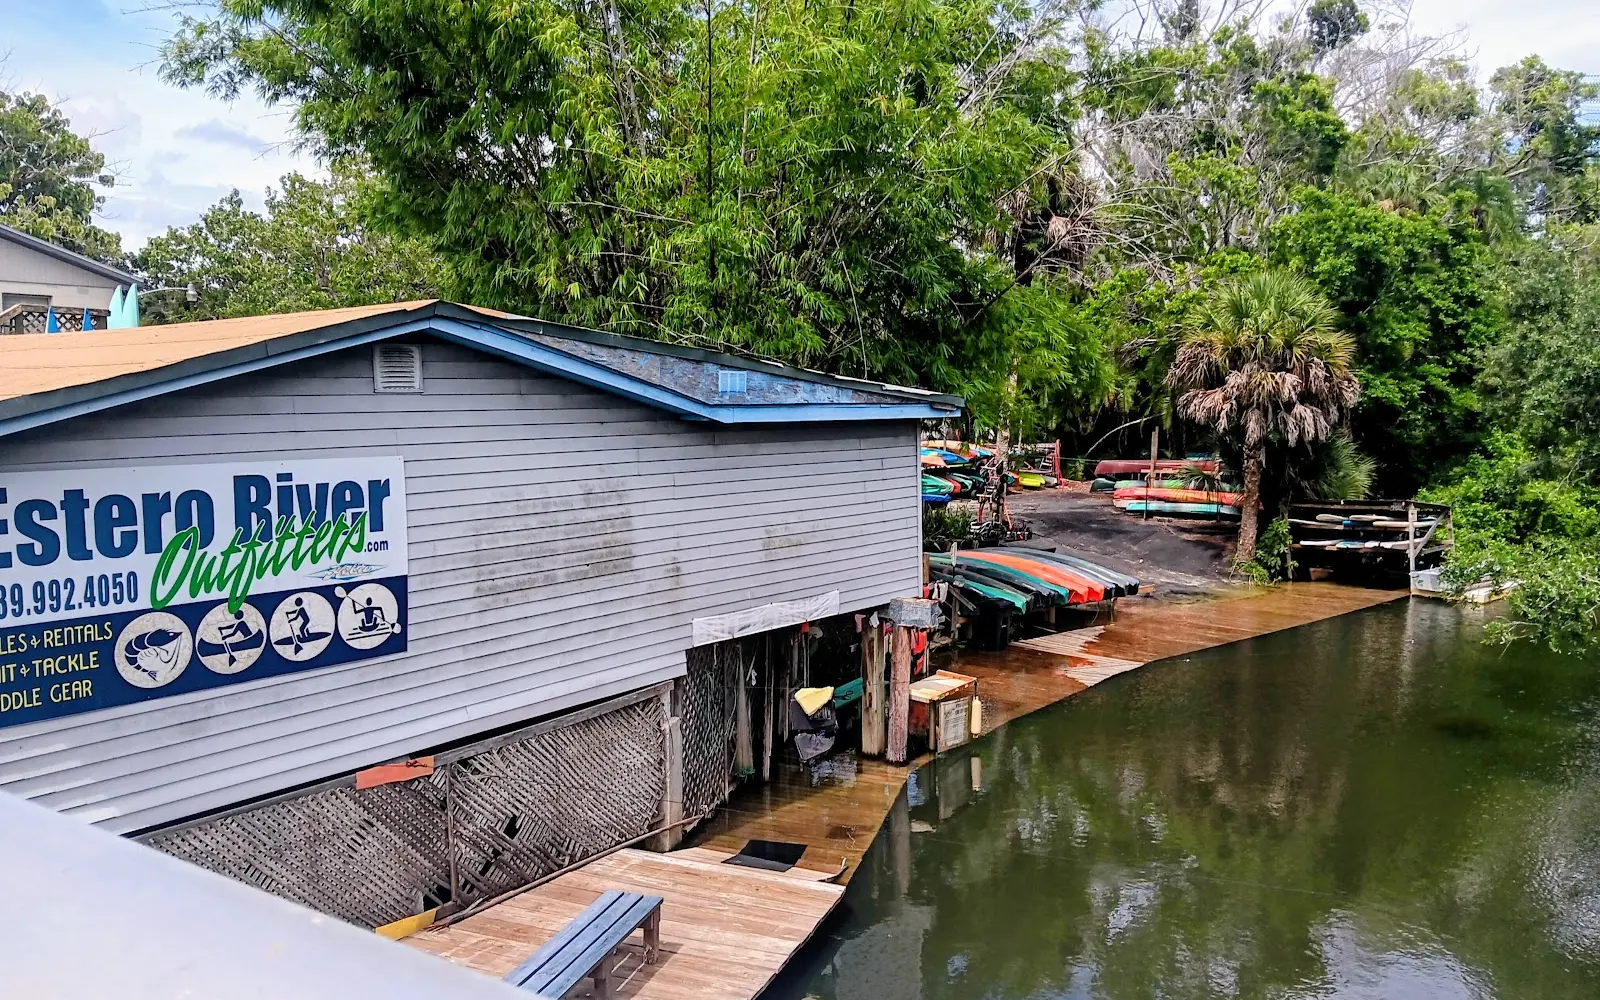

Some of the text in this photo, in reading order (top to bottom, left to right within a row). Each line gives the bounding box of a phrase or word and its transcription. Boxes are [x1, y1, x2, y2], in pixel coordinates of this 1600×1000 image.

[233, 472, 390, 545] River
[150, 510, 389, 614] Outfitters .com
[30, 634, 41, 649] &
[43, 621, 113, 649] RENTALS
[0, 651, 99, 684] IT & TACKLE
[0, 679, 93, 712] DDLE GEAR
